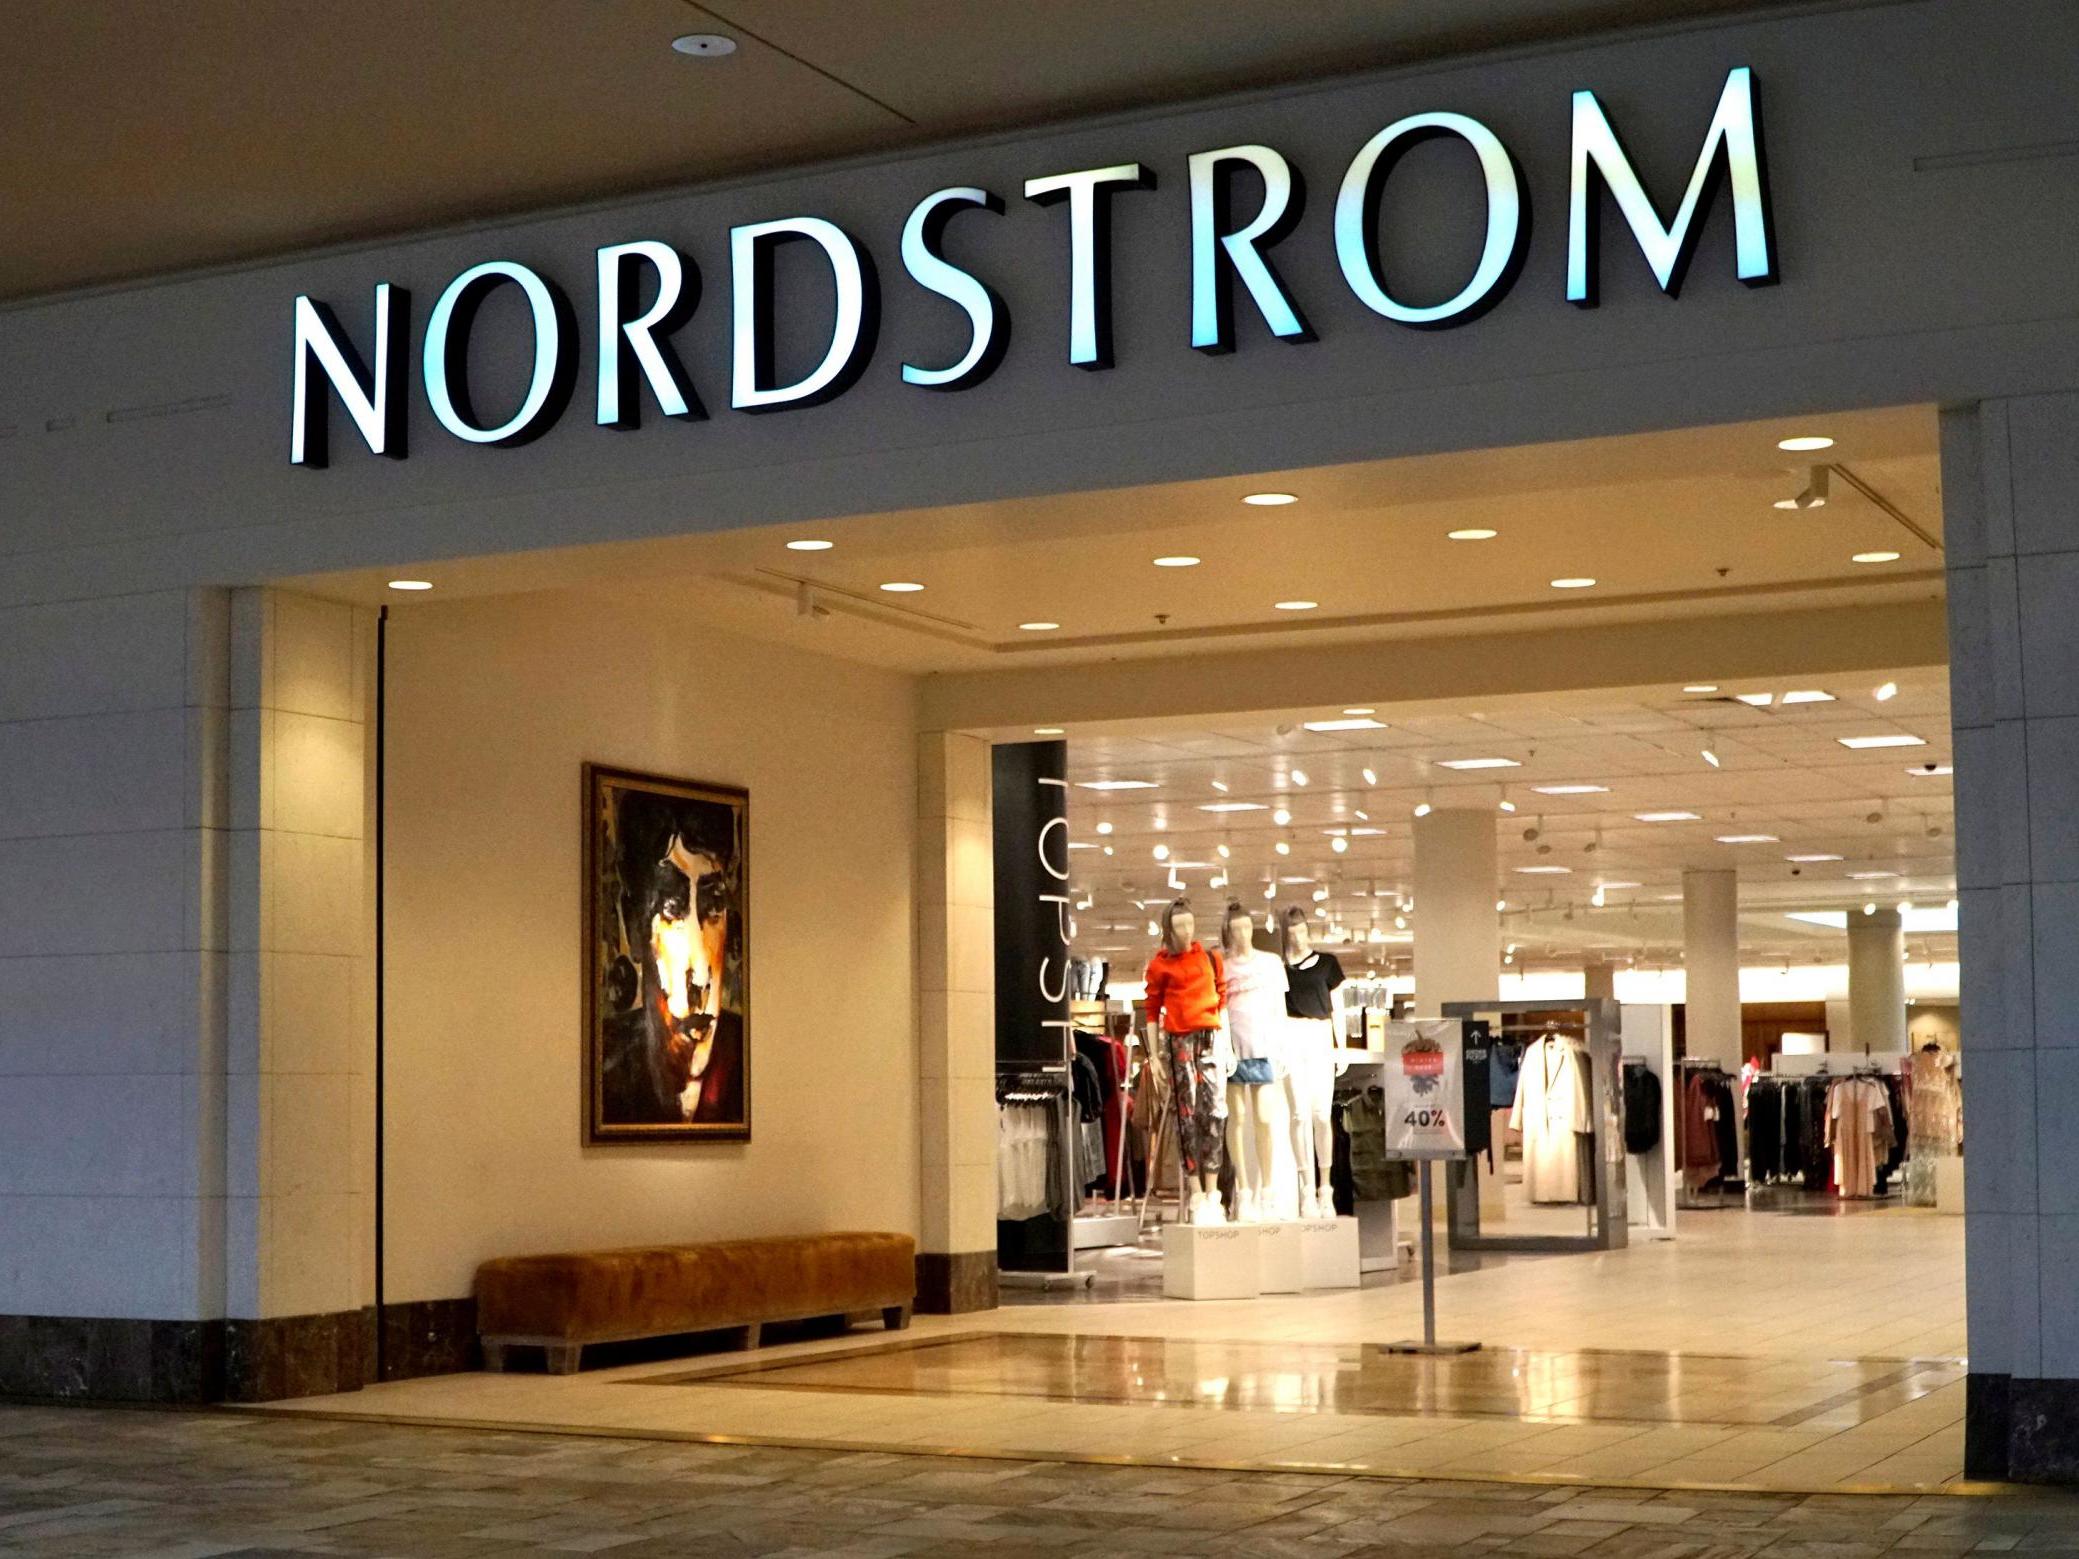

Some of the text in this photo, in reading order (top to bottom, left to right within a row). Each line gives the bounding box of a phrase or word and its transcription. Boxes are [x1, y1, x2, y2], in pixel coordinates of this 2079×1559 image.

[290, 65, 1776, 467] NORDSTROM
[1404, 1109, 1445, 1127] 40%
[1197, 1230, 1240, 1240] TOPSHOP
